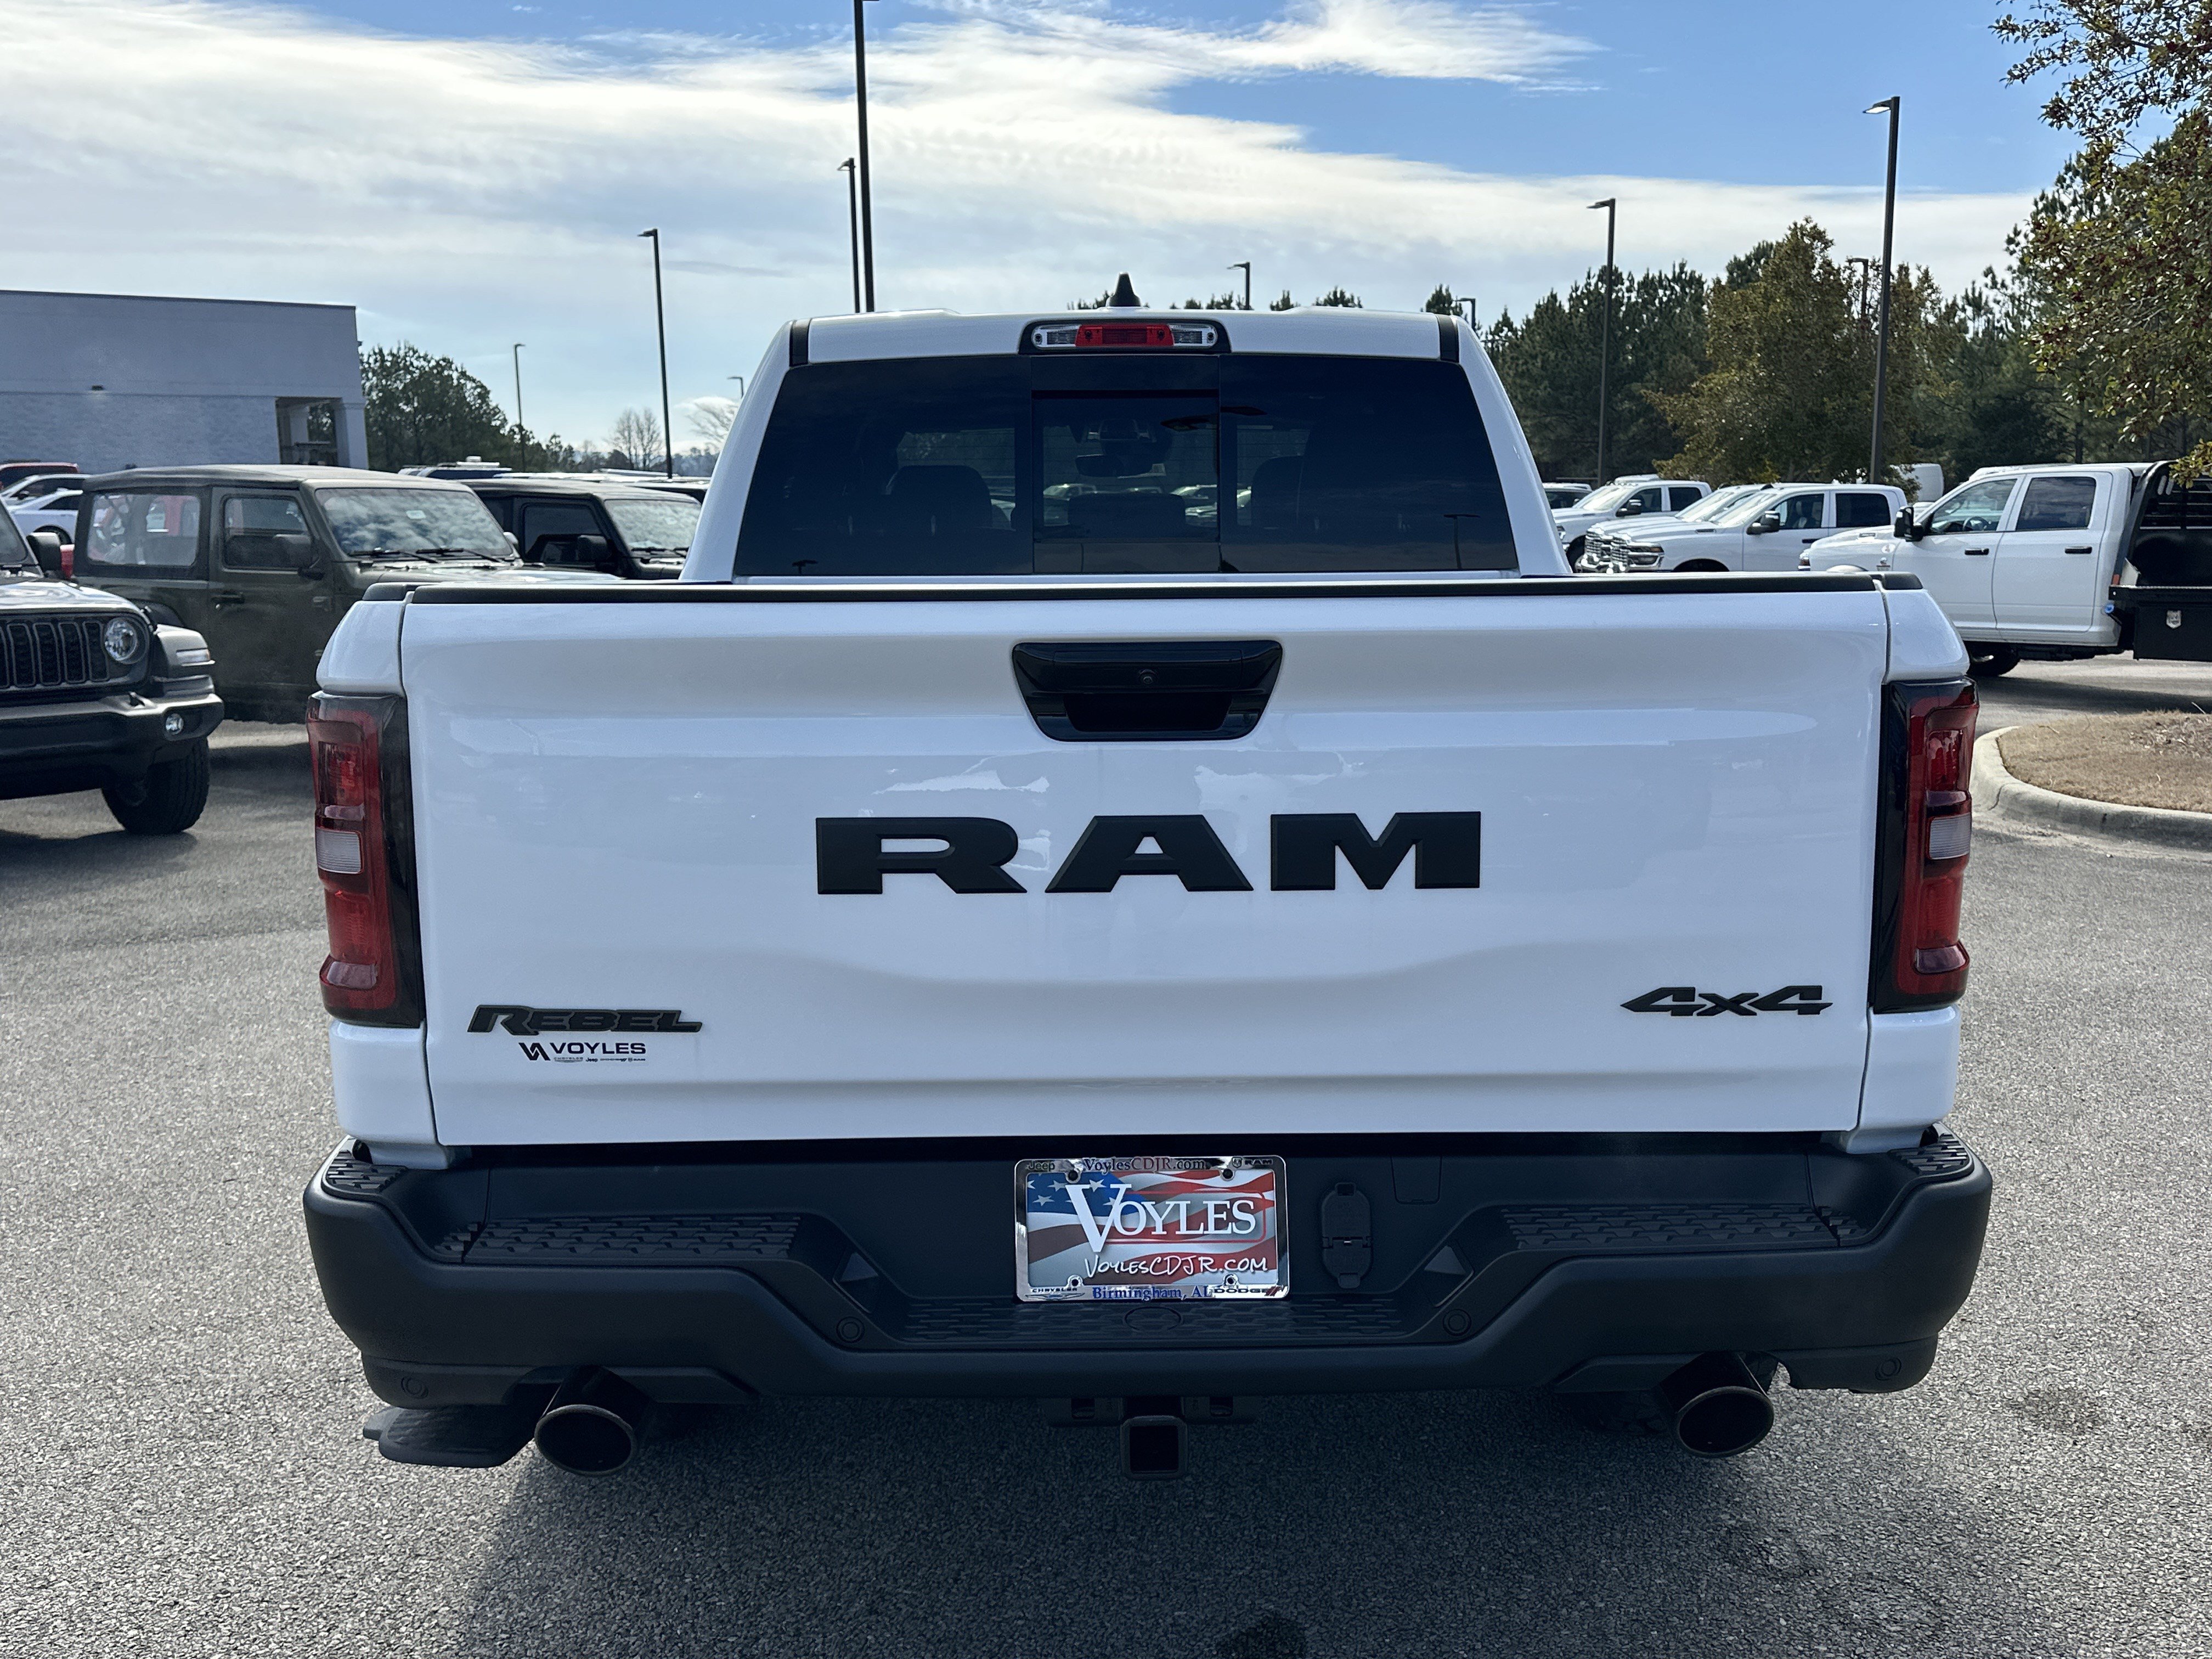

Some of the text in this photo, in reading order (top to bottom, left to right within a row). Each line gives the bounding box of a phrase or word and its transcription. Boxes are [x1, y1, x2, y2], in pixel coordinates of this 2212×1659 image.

[816, 811, 1481, 895] RAM
[1620, 985, 1833, 1016] 4x4
[467, 1005, 703, 1036] REBEL
[550, 1042, 646, 1054] VOYLES
[1028, 1160, 1056, 1171] Jeep
[1083, 1156, 1205, 1174] VoylesCDJR.com
[1065, 1183, 1257, 1253] VOYLES
[1092, 1286, 1187, 1301] Birmingham,
